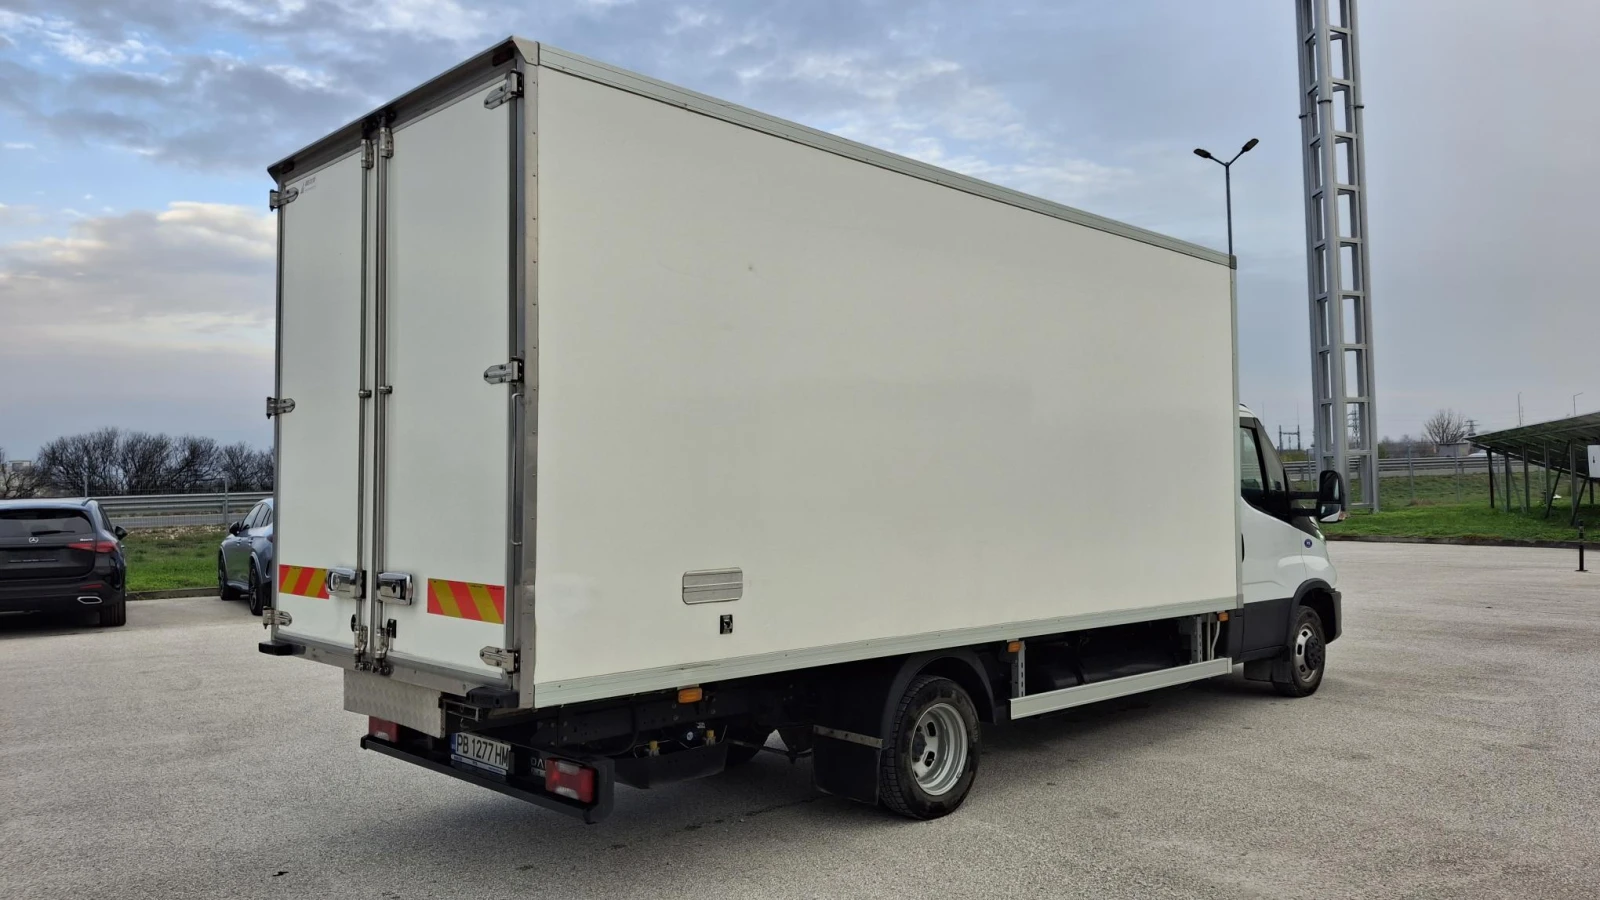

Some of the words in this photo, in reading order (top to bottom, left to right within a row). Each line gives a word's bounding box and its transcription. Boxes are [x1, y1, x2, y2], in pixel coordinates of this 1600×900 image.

[457, 734, 469, 754] PB
[472, 738, 494, 761] 1277
[495, 744, 509, 767] HM
[530, 756, 544, 769] DA
